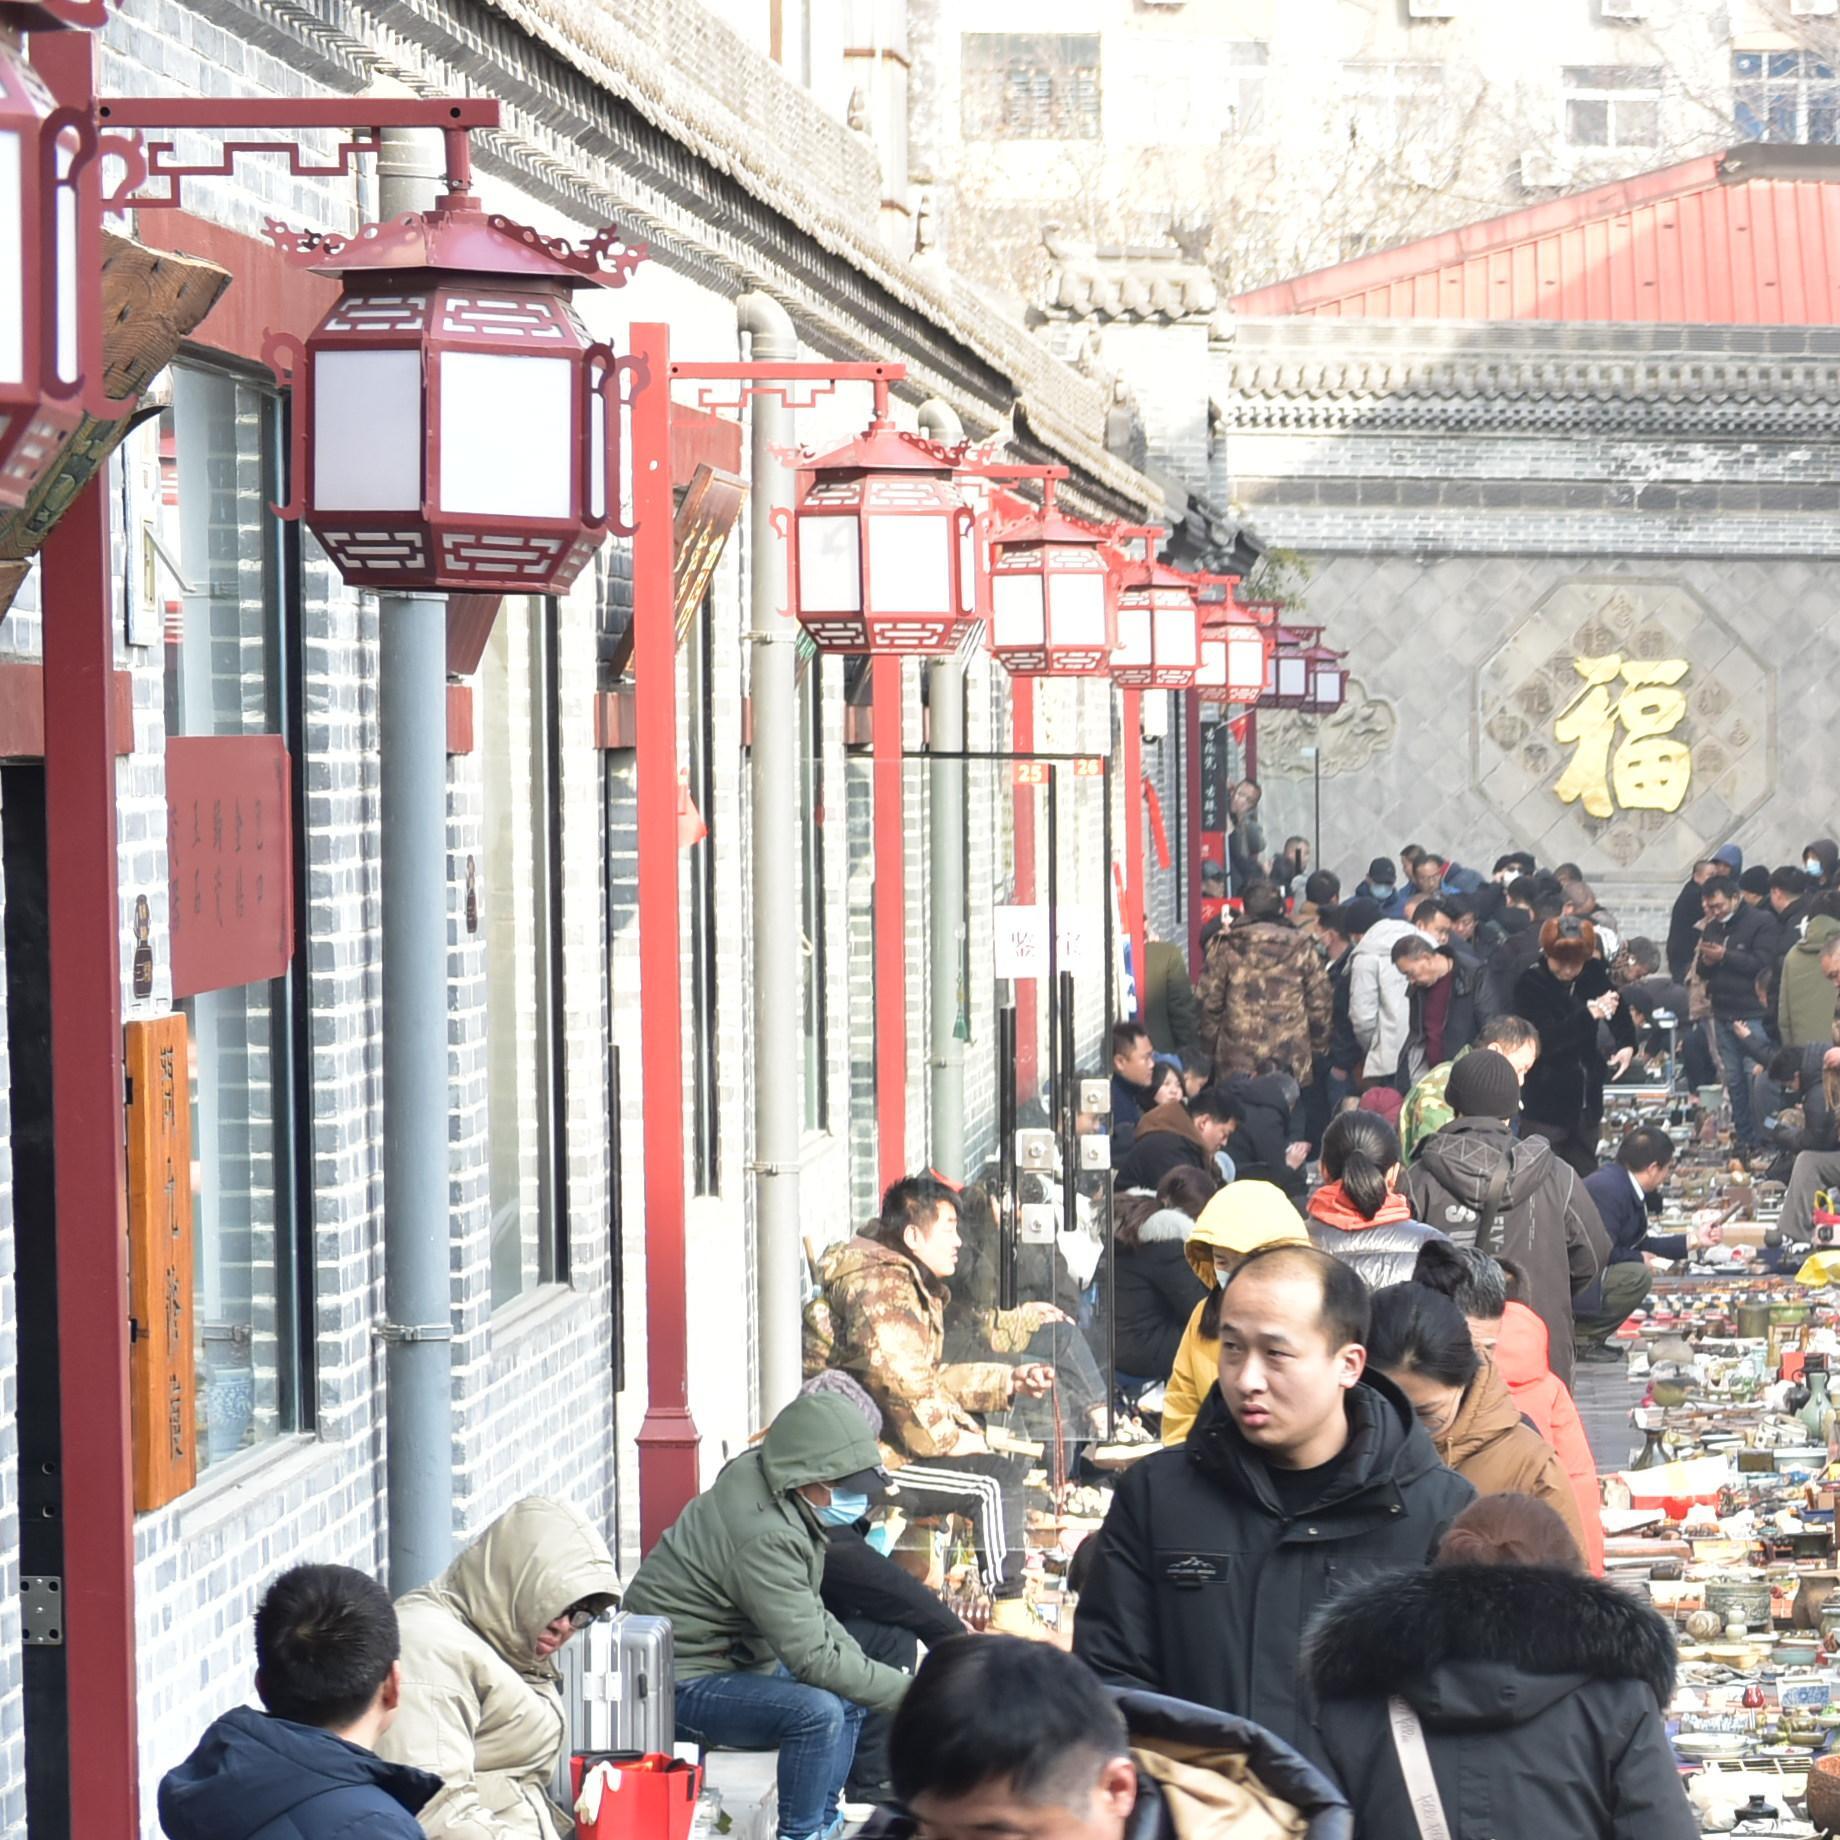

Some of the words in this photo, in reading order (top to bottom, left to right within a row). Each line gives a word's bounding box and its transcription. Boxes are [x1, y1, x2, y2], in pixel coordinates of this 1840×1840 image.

[1554, 654, 1692, 818] 福
[1018, 764, 1043, 783] 25
[1077, 759, 1099, 776] 26
